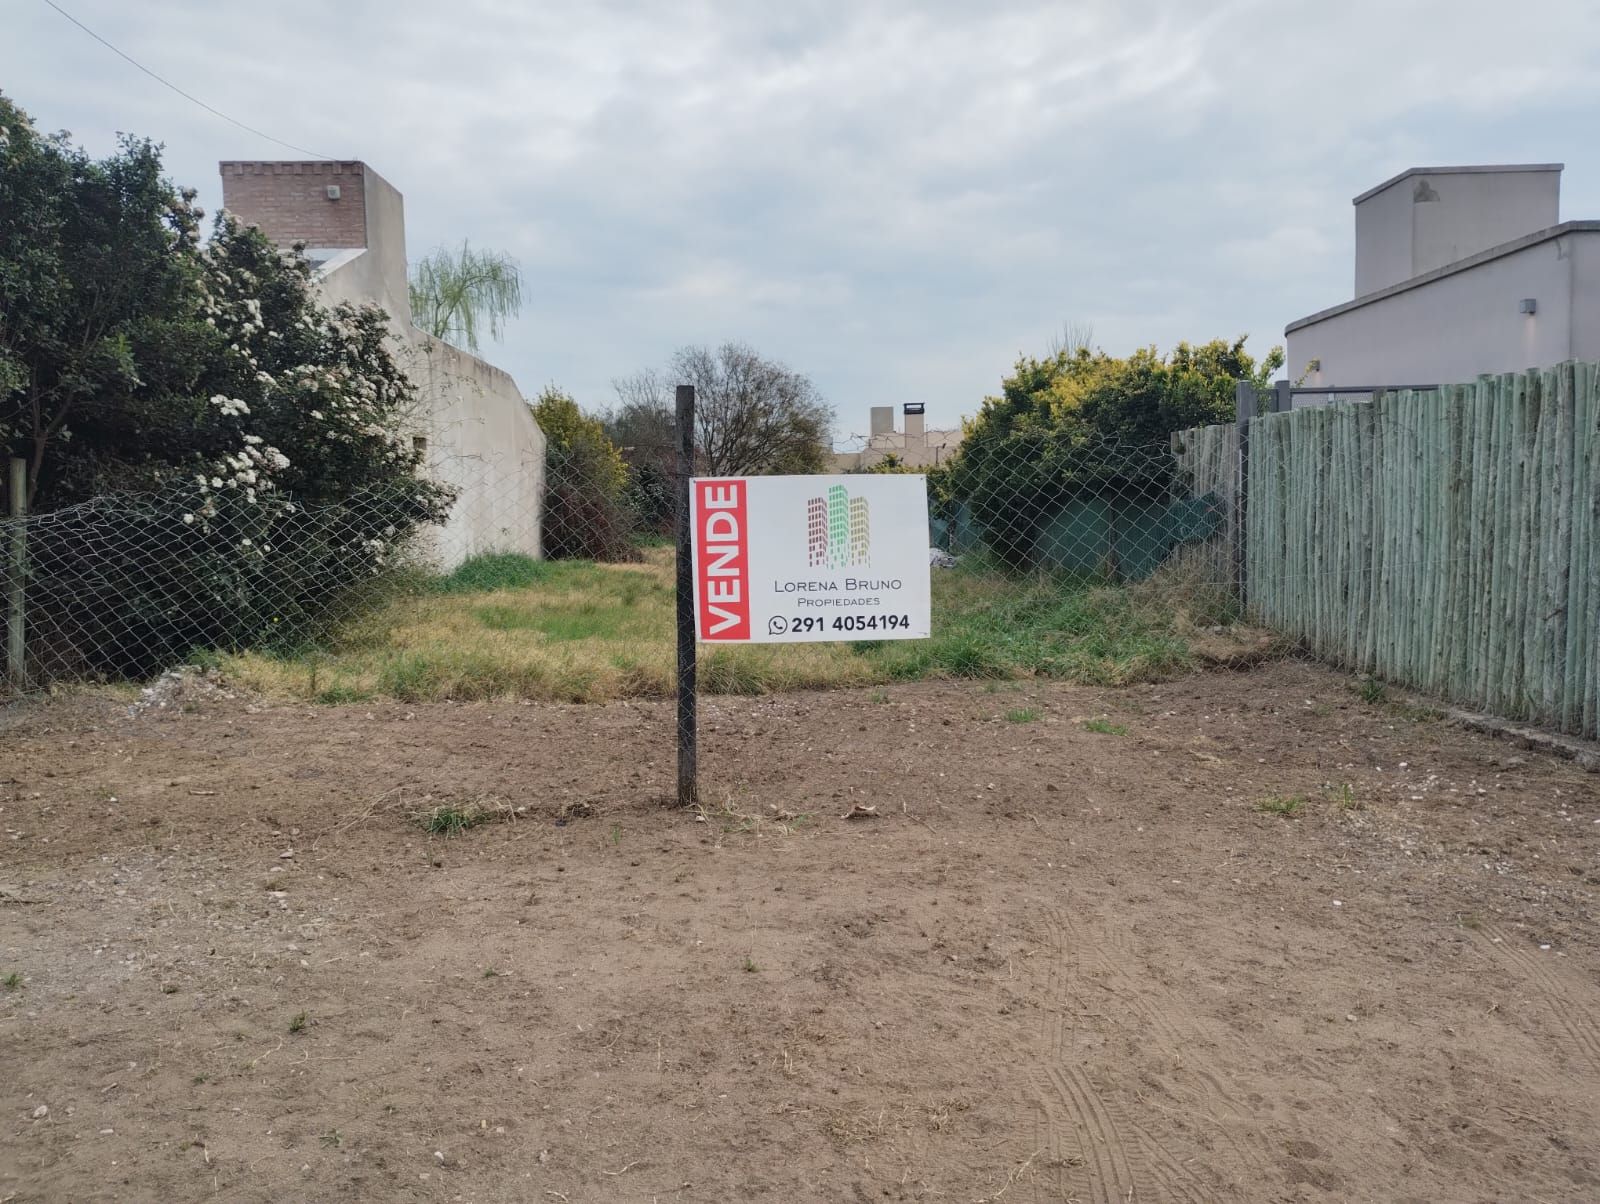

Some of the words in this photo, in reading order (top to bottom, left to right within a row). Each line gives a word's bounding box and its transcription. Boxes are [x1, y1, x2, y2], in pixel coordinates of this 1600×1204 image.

[704, 484, 742, 636] VENDE
[791, 616, 825, 633] 291
[832, 614, 911, 632] 4054194
